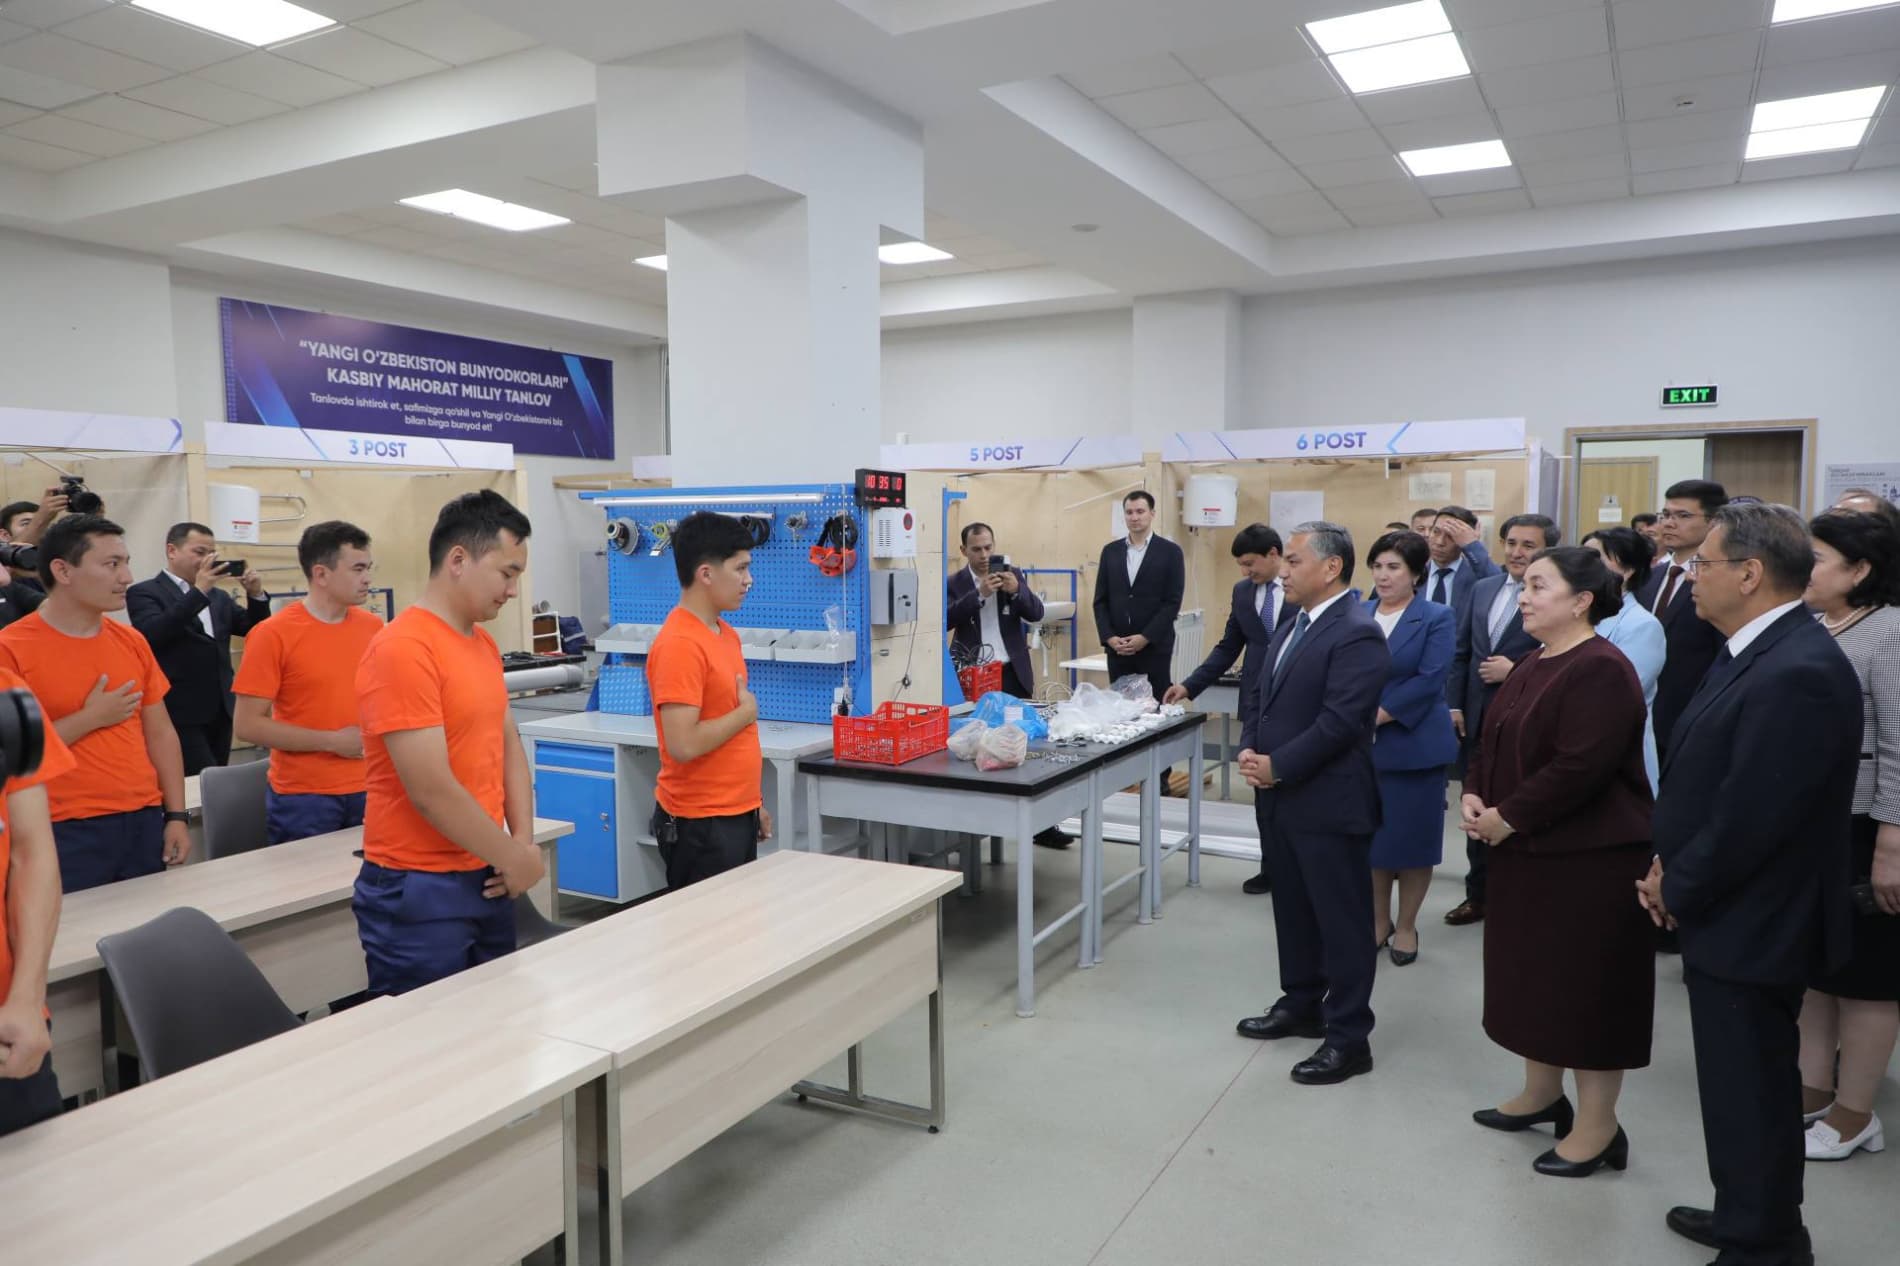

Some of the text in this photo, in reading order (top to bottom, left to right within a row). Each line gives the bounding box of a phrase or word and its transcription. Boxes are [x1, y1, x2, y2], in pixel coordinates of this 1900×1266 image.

[327, 367, 551, 407] KASBIY MAHORAT MILLIY TANLOV
[1669, 388, 1710, 403] EXIT
[310, 392, 354, 406] Tanlovda
[356, 396, 389, 410] ishtirok
[471, 411, 481, 419] va
[482, 410, 504, 422] Yangi
[405, 415, 426, 425] bilan
[428, 416, 449, 429] birga
[451, 420, 480, 431] bunyod
[349, 439, 407, 458] 3 POST
[1296, 431, 1367, 450] 6 POST
[970, 446, 1024, 461] 5 POST
